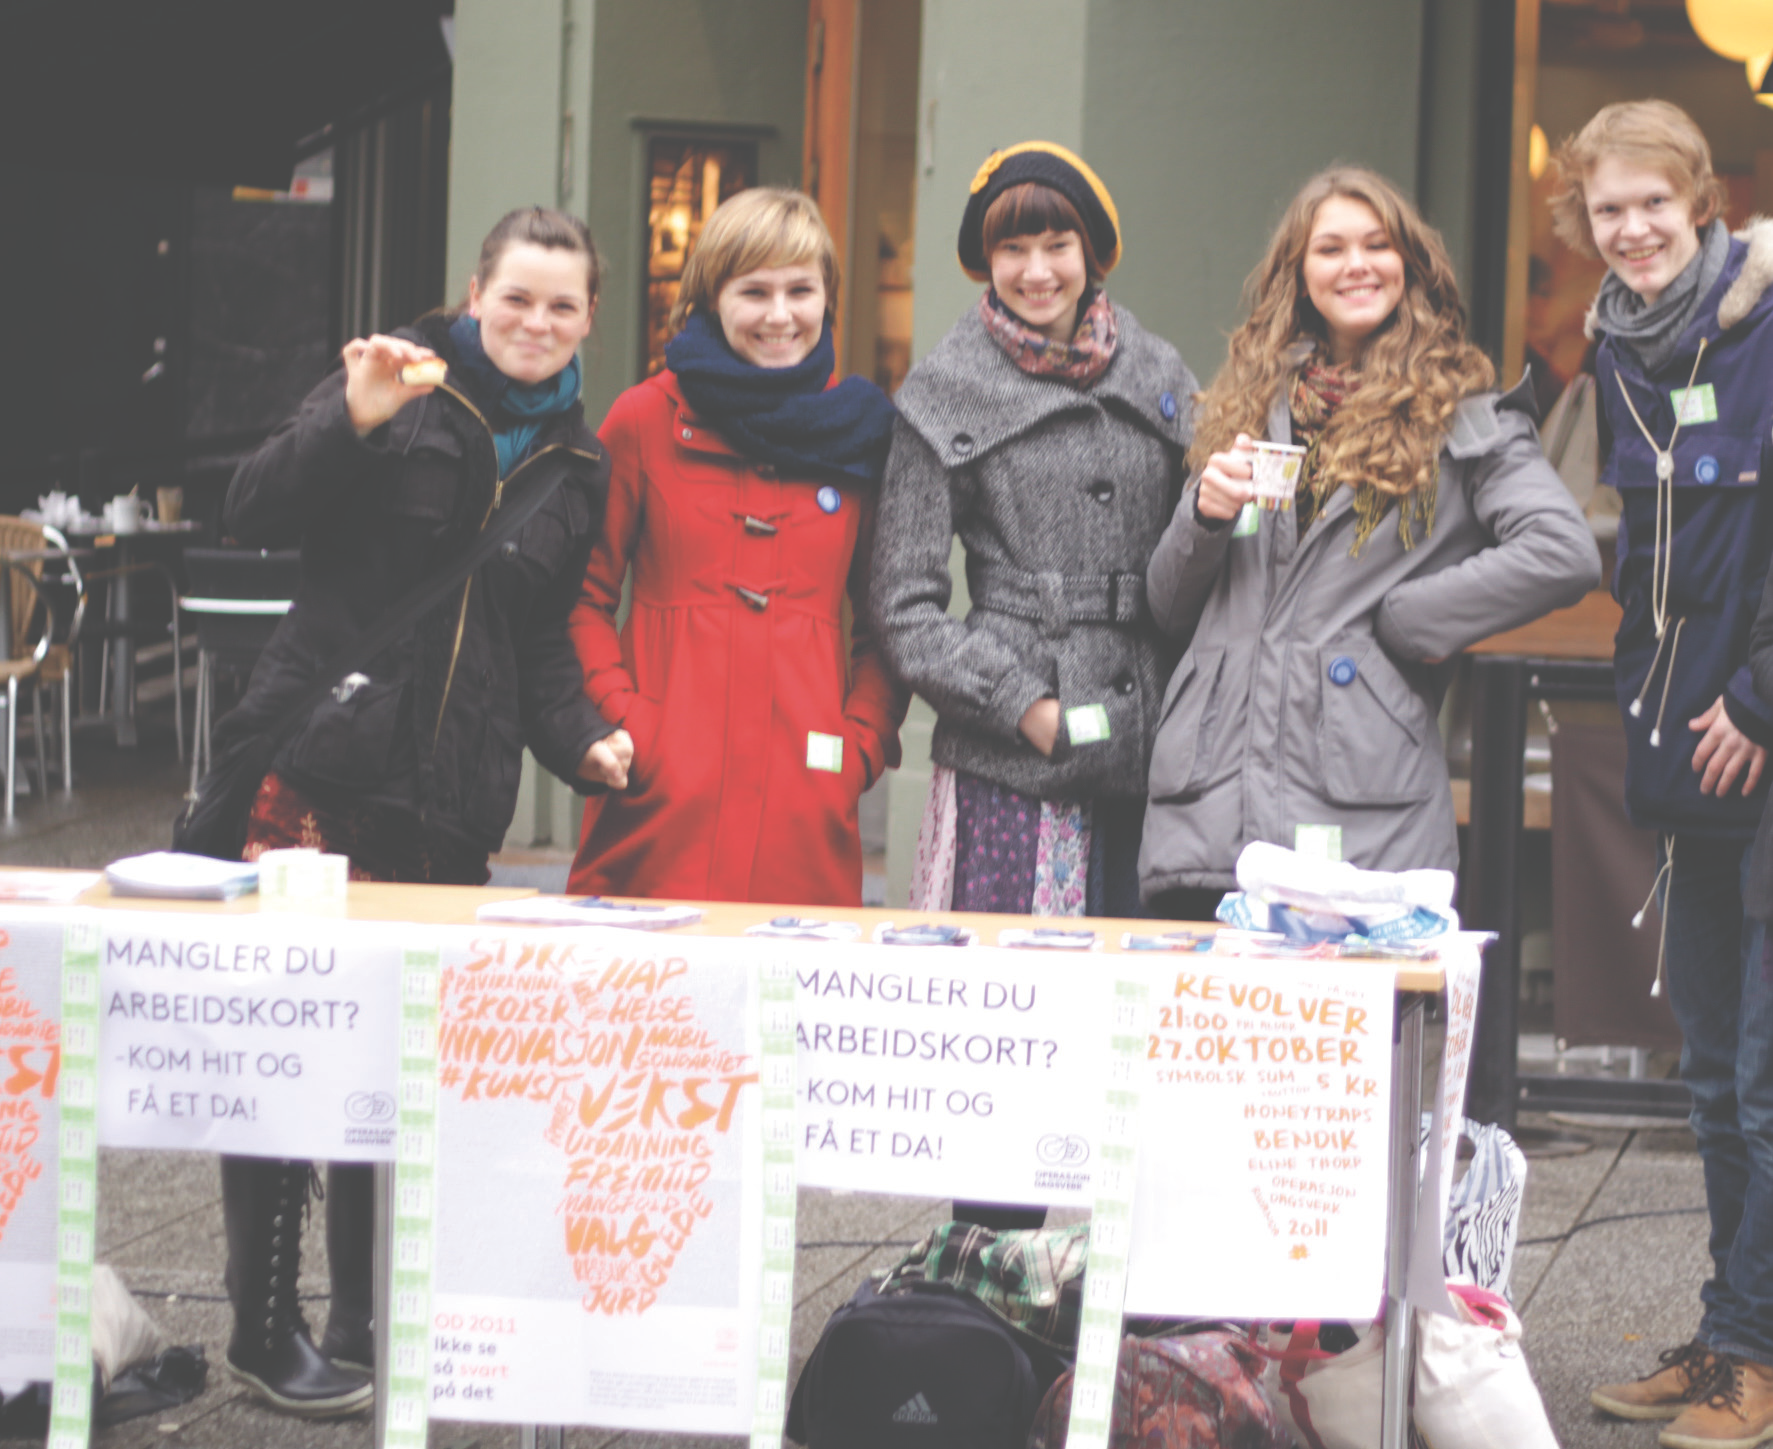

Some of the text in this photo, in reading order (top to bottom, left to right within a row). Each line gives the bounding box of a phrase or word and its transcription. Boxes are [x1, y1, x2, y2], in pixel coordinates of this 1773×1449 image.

[106, 938, 336, 975] MANGLER DU
[797, 968, 1036, 1012] MANGLER DU
[1173, 972, 1369, 1036] REVOLVER
[107, 991, 360, 1030] ARBEIDSKORT?
[607, 991, 696, 1026] HELSE
[1158, 1003, 1229, 1031] 21:00
[438, 1021, 645, 1073] INNOVASJON
[797, 1021, 1058, 1069] ARBEIDSKORT?
[115, 1046, 303, 1079] -KOM HIT OG
[1156, 1069, 1379, 1099] SYMBOLSK SUM 5 KR
[127, 1084, 259, 1121] FÅ ET DA!
[577, 1070, 759, 1134] VEKST
[887, 1085, 937, 1113] HIT
[946, 1089, 994, 1118] OG
[1243, 1102, 1374, 1124] HONEYTRAPS
[805, 1118, 943, 1161] FÅ ET DA!
[1253, 1128, 1359, 1153] BENDIK
[563, 1156, 709, 1193] FREMTID
[1272, 1175, 1357, 1198] OPERASJON
[1270, 1193, 1342, 1215] DAGSVERK
[564, 1213, 657, 1259] VALG
[1288, 1218, 1329, 1238] 2011
[581, 1283, 658, 1317] JORD
[434, 1312, 518, 1335] OD 2011
[434, 1336, 497, 1355] Ikke se
[433, 1360, 510, 1380] så svart
[433, 1382, 494, 1402] på det
